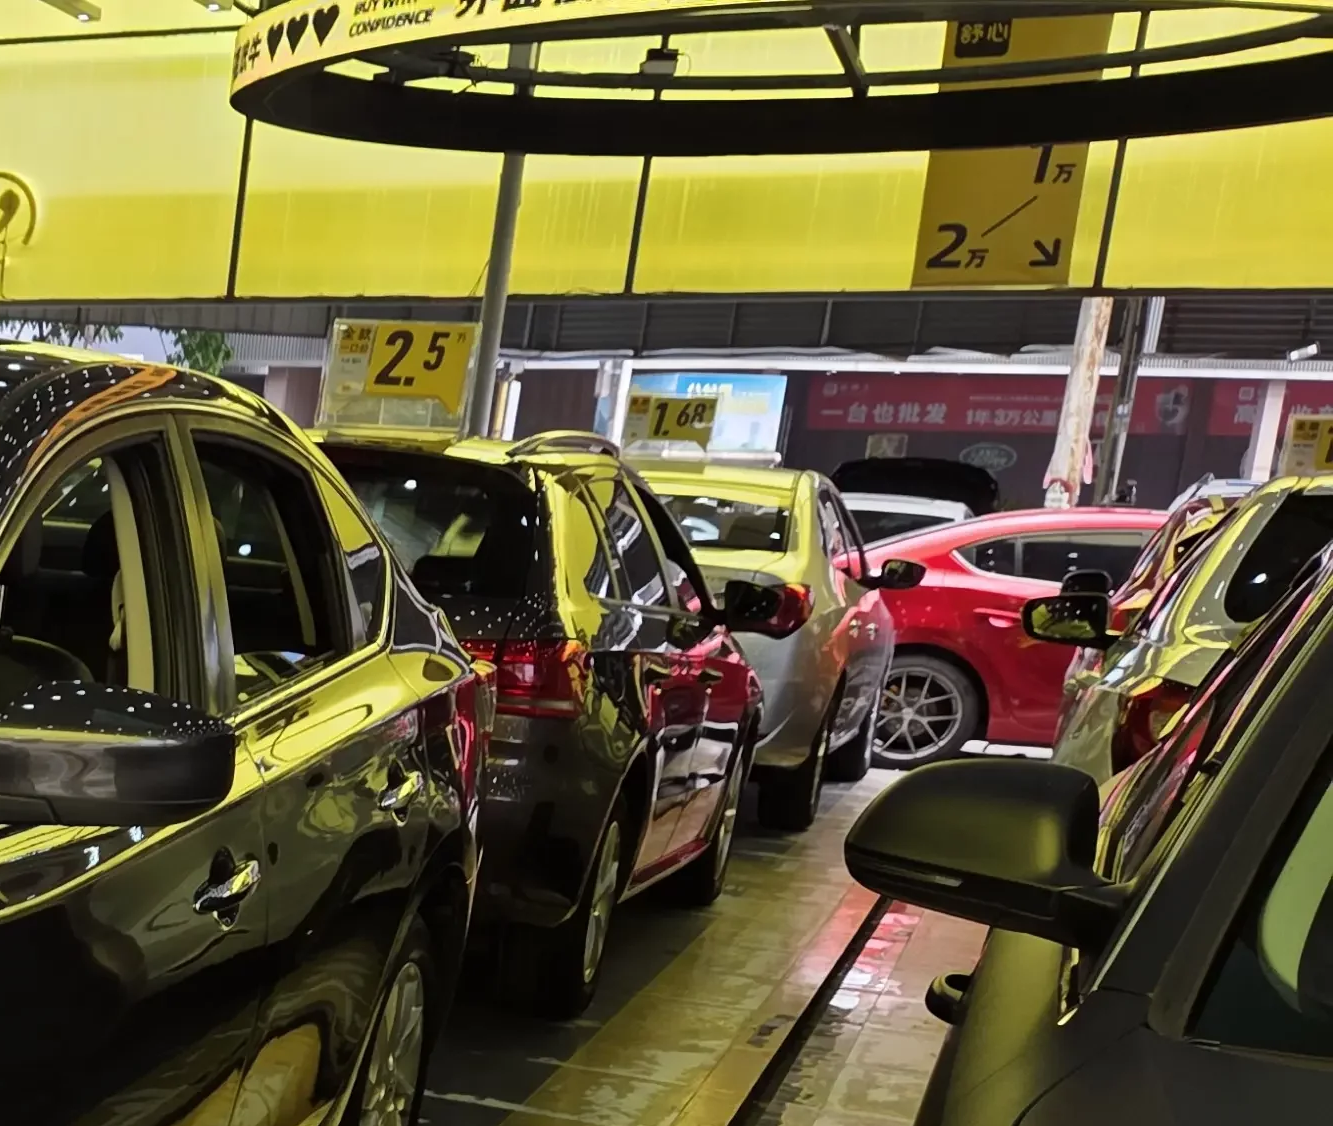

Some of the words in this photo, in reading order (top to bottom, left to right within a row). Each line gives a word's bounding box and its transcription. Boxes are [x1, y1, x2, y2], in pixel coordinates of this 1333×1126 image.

[349, 8, 434, 37] CONFIDENCE
[820, 402, 947, 425] 一台也批发
